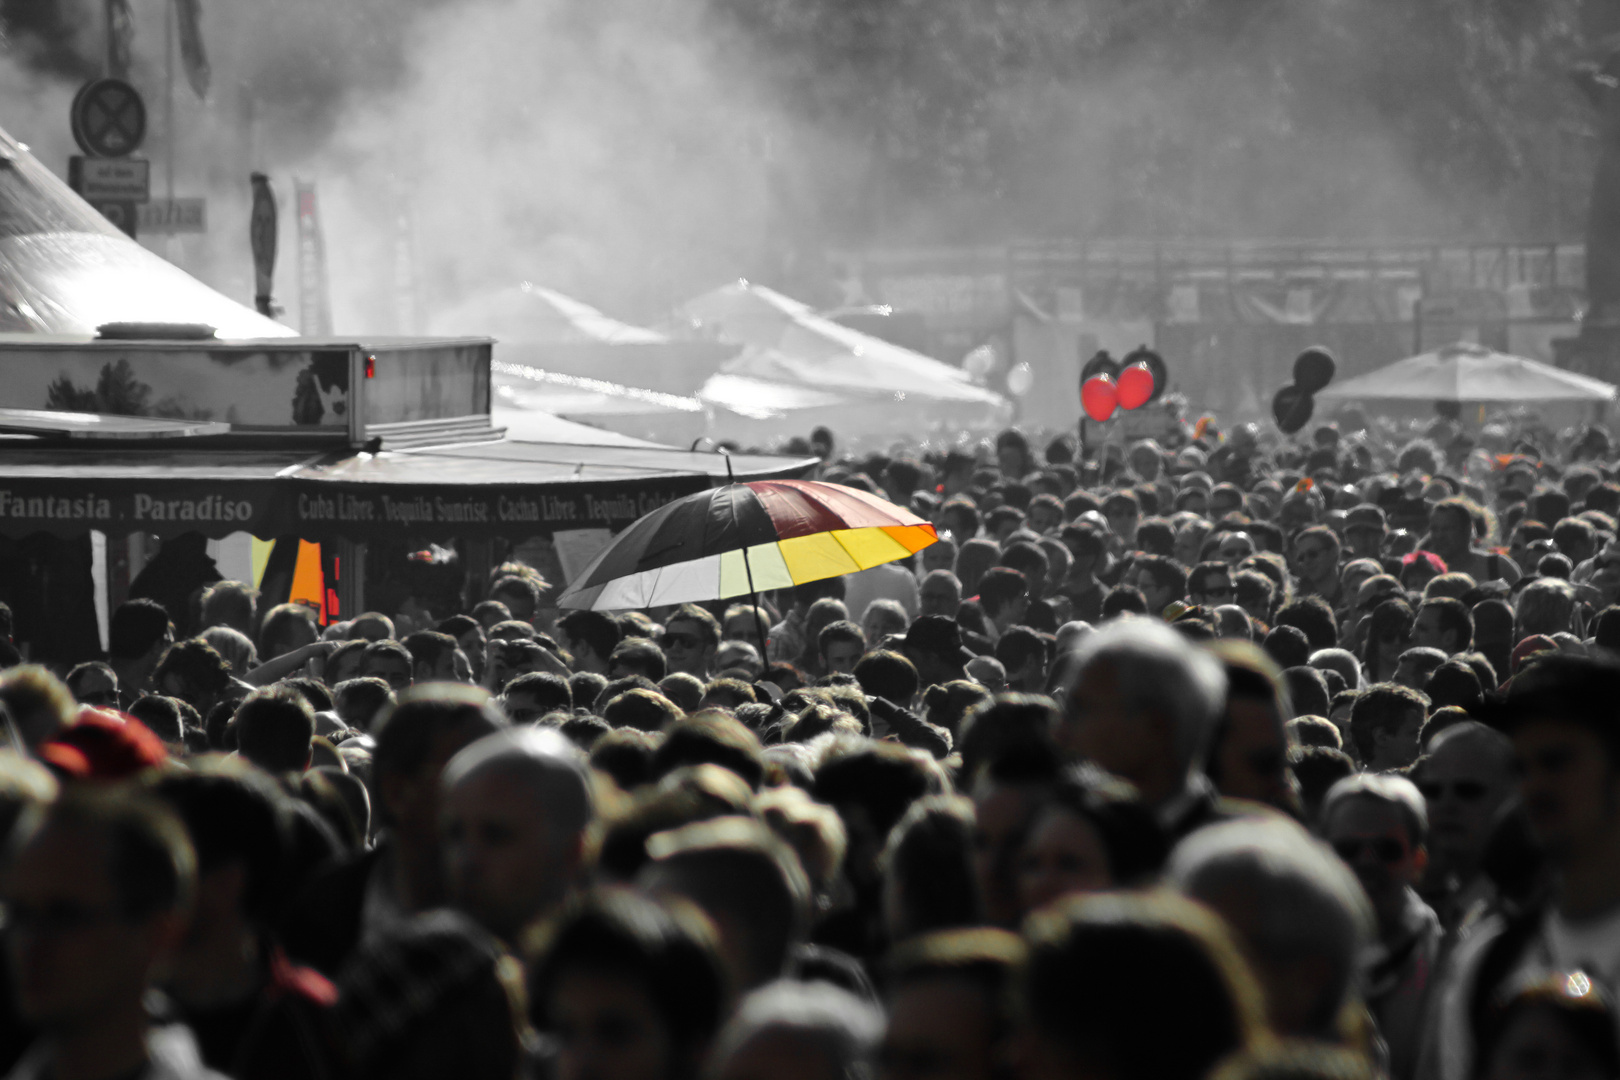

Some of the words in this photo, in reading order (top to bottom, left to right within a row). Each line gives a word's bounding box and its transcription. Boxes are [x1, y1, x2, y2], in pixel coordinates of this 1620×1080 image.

[0, 490, 111, 519] Fantasia
[134, 493, 253, 521] Paradiso
[298, 492, 335, 520] Cuba
[337, 492, 374, 520] Libre
[381, 495, 433, 527] Tequila
[435, 495, 488, 522] Sunrise
[541, 494, 576, 521] Libre
[583, 492, 637, 525] Tequila
